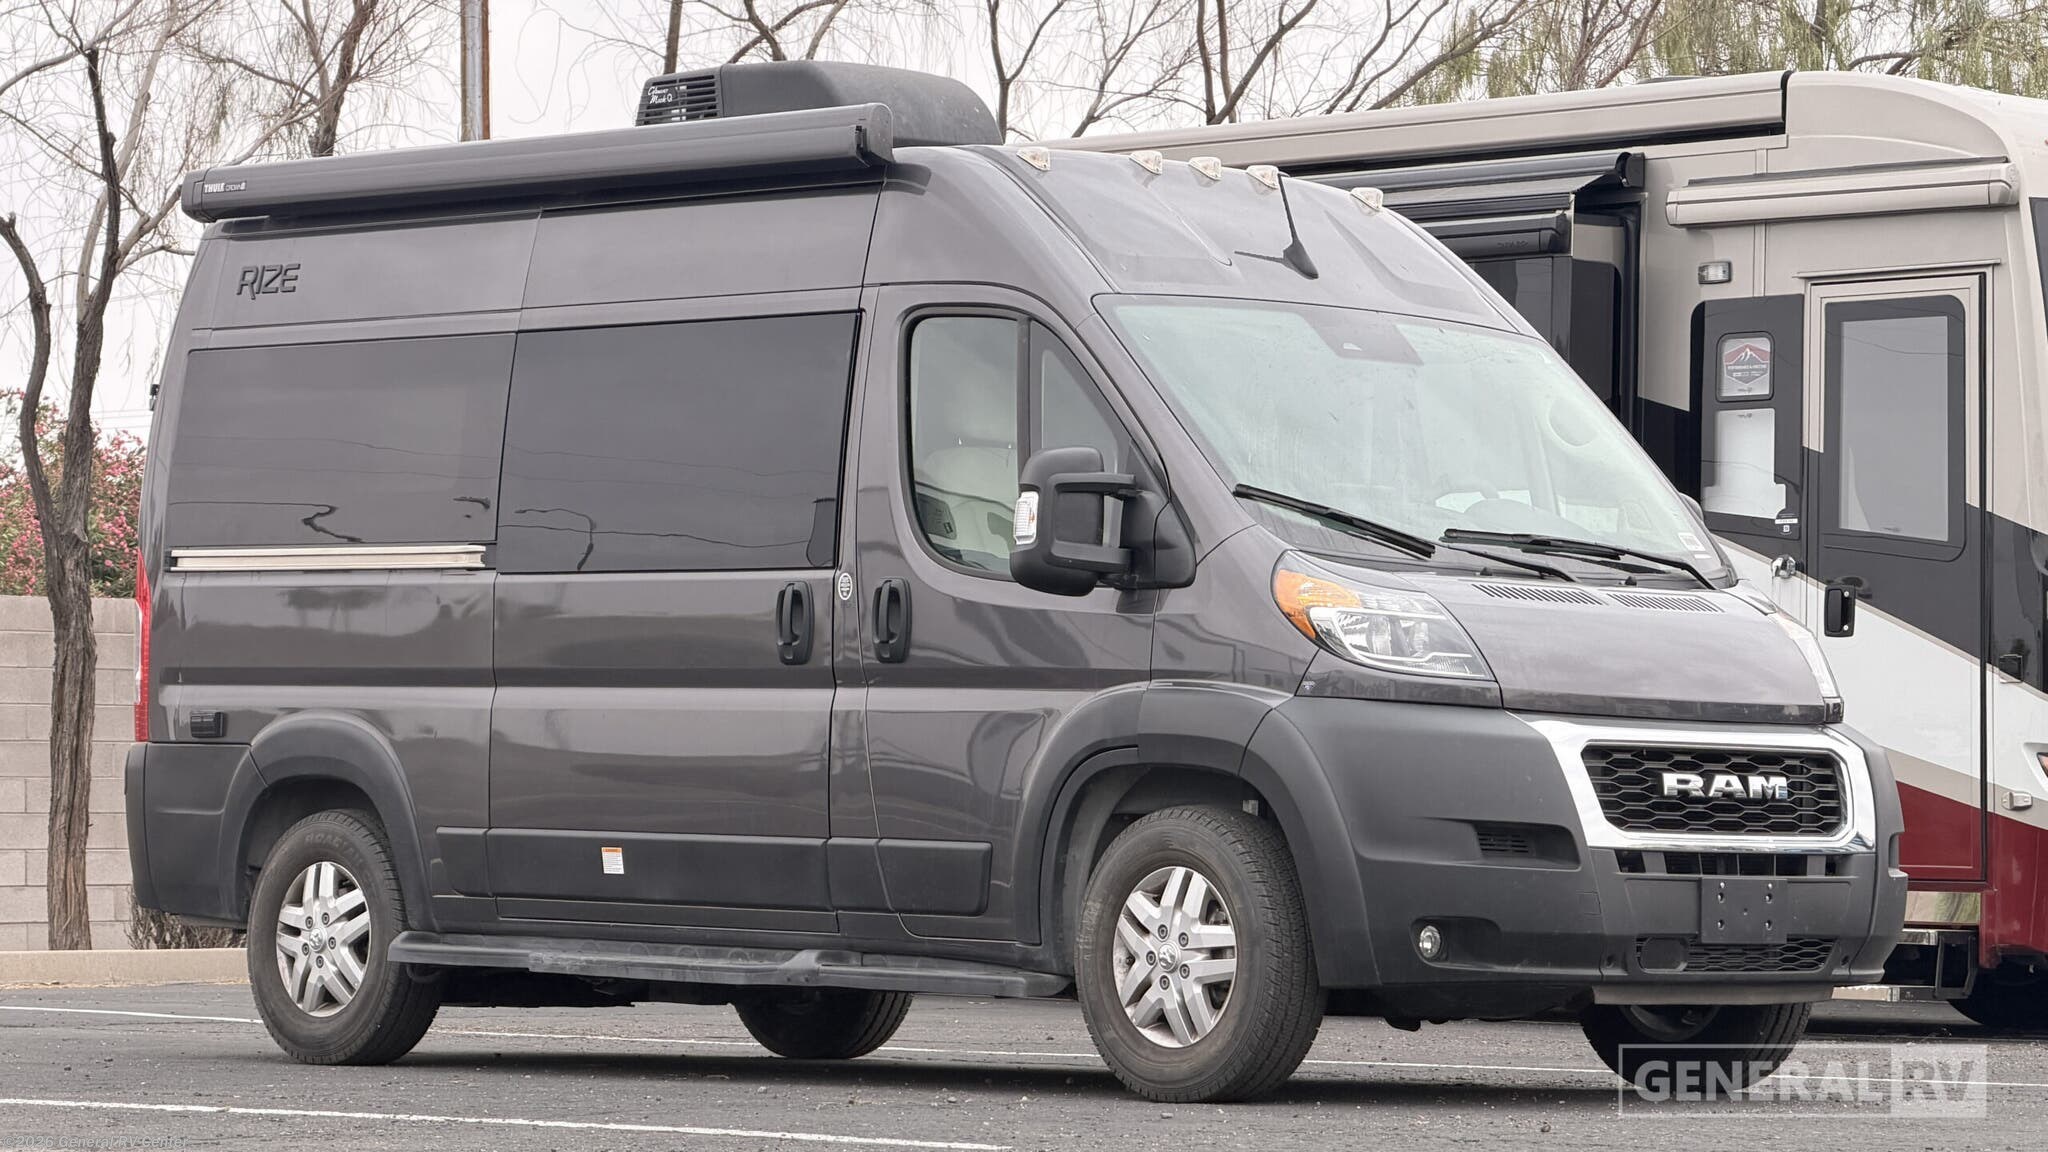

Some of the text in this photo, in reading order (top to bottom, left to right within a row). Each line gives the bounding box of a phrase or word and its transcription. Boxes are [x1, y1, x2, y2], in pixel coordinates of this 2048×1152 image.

[204, 183, 225, 193] THULE
[236, 264, 301, 300] RIZE
[1662, 773, 1788, 799] RAM
